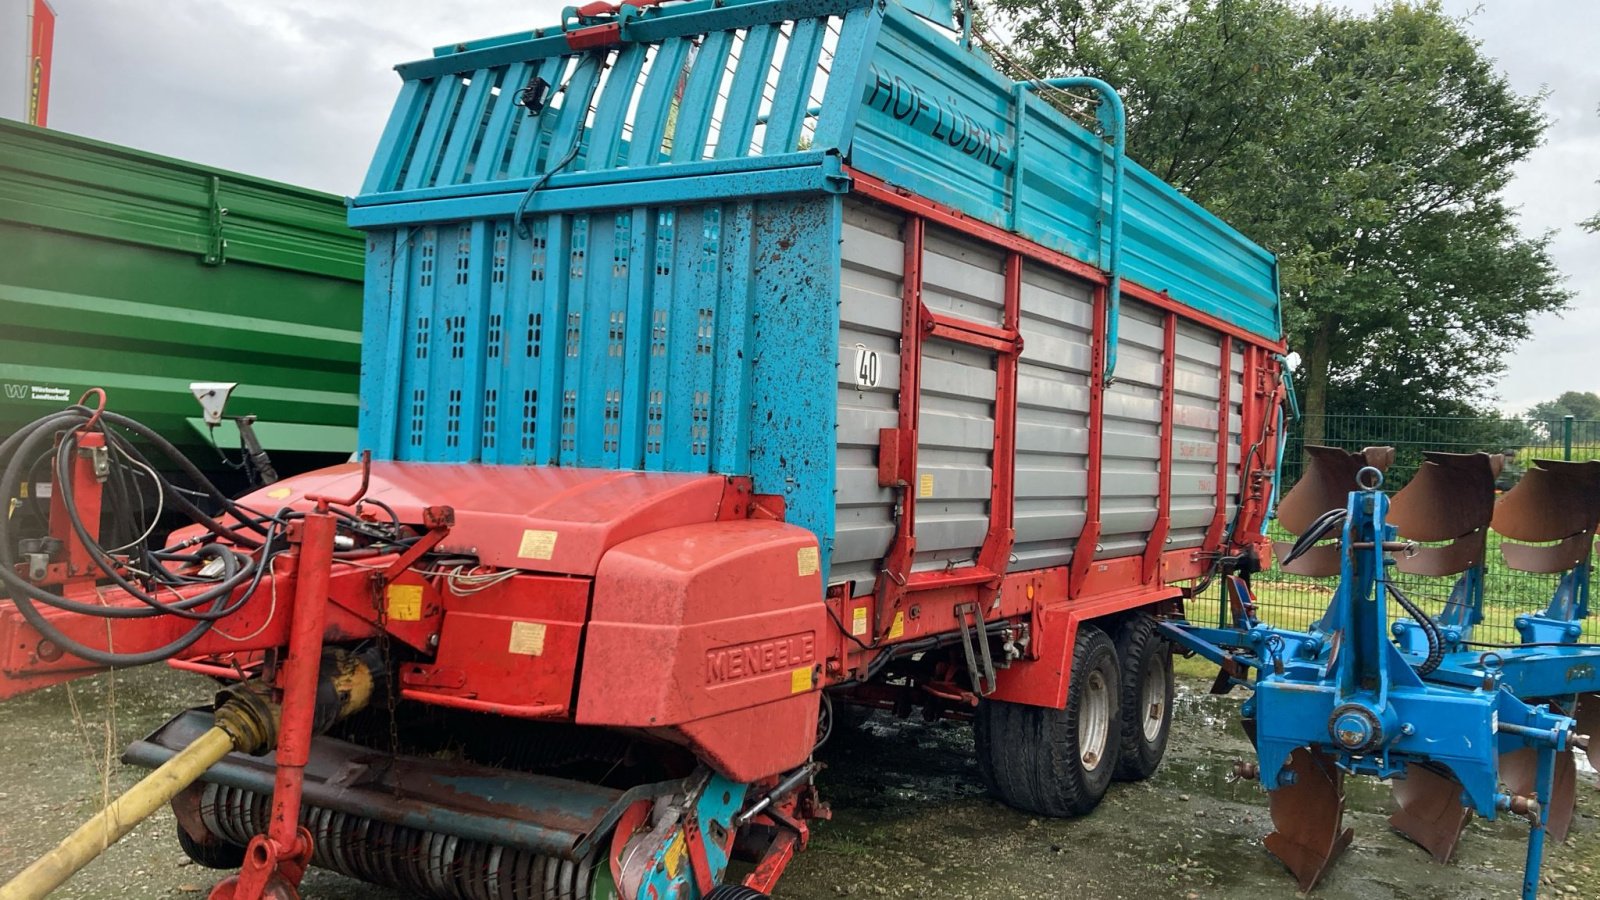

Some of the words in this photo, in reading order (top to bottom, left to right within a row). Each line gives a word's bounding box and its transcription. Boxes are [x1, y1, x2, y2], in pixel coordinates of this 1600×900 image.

[868, 62, 930, 126] HOF
[859, 350, 877, 386] 40
[705, 635, 814, 684] MENGELE
